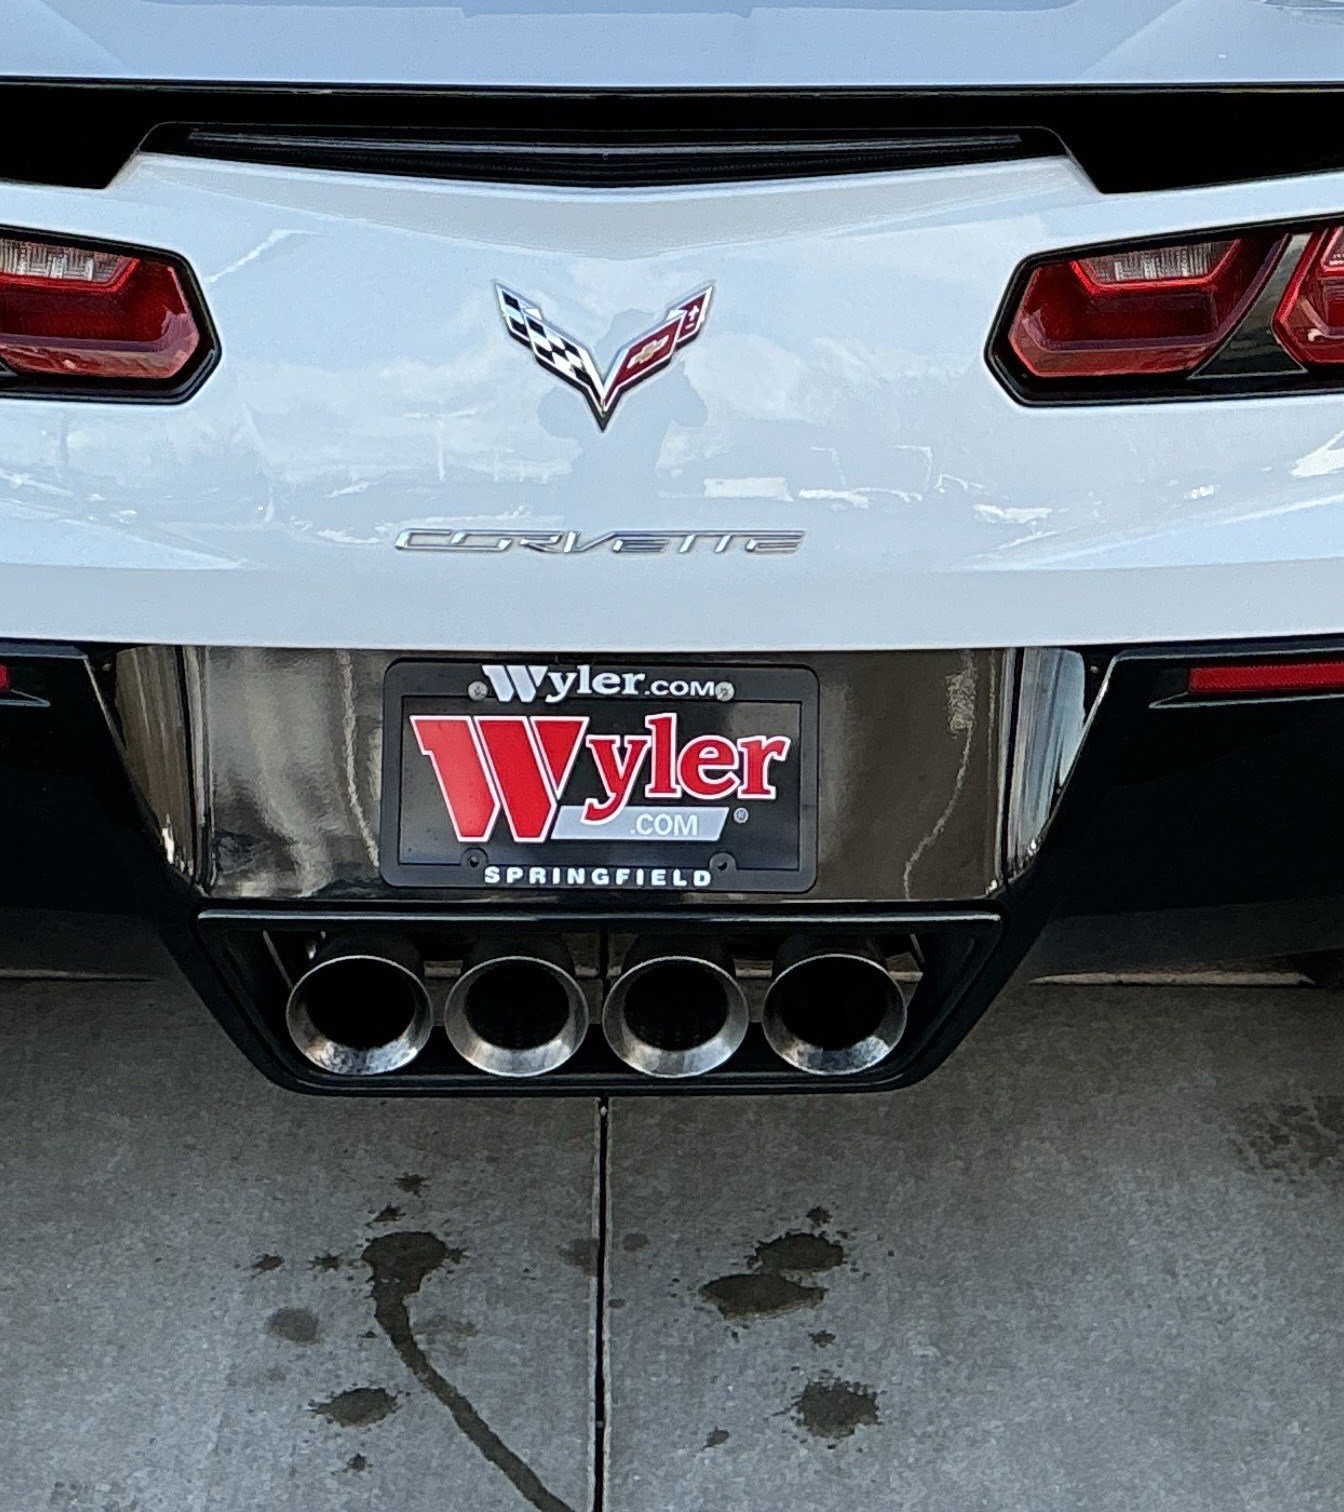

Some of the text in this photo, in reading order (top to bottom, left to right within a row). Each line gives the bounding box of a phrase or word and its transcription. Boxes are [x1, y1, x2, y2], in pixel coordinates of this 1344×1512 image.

[394, 528, 805, 554] CORVETTE
[410, 712, 791, 842] Wyler
[629, 813, 698, 837] .COM
[484, 867, 712, 887] SPRINGFIELD
